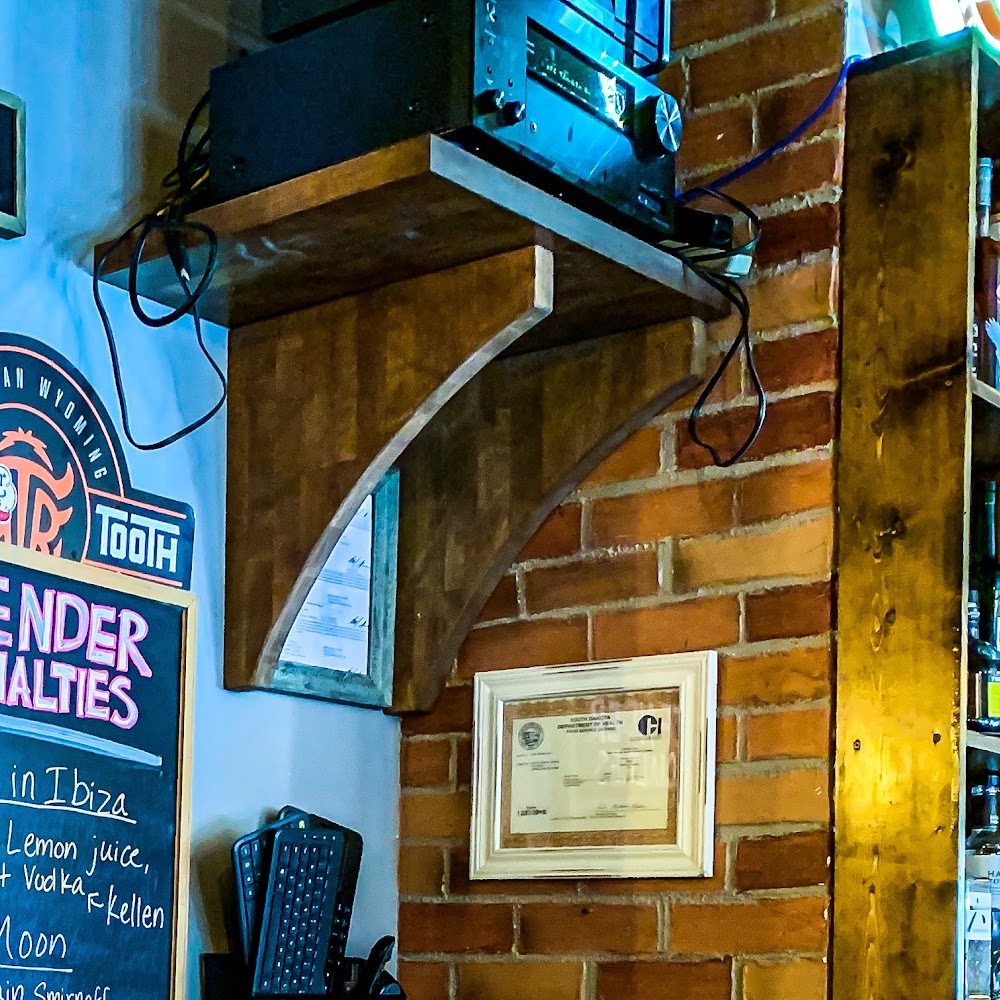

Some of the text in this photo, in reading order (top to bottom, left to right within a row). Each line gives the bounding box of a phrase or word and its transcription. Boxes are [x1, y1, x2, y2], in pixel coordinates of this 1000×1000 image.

[39, 376, 107, 479] WYOMING
[95, 505, 180, 573] TOOTH
[11, 765, 35, 800] in
[44, 767, 128, 816] Ibiza
[6, 820, 77, 860] Lemon
[24, 864, 85, 895] Vodka
